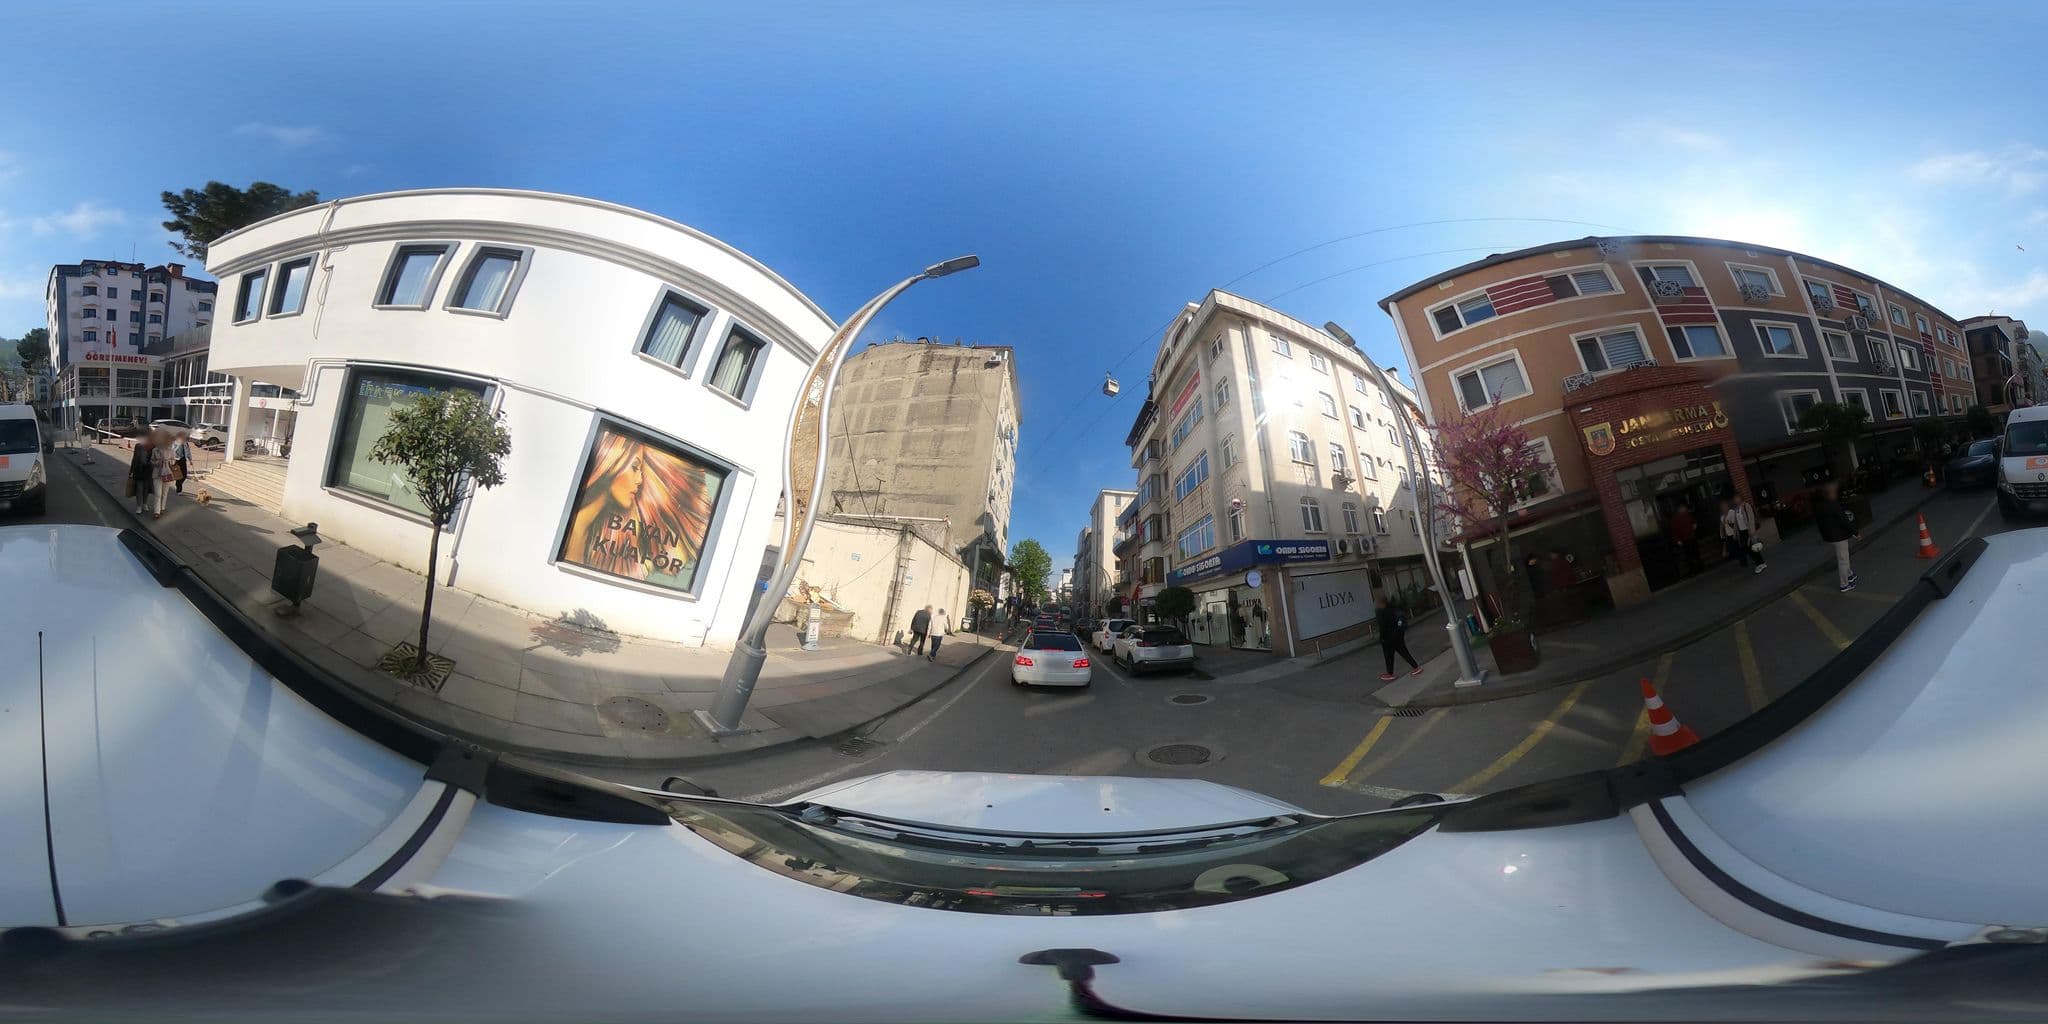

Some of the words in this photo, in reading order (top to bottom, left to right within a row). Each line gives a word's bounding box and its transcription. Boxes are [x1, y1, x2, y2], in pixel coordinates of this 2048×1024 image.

[85, 351, 148, 364] ÖĞRETMENEVİ
[1620, 405, 1708, 434] JANRMA
[608, 512, 680, 547] BAYAN
[593, 536, 683, 574] KUAFÖR
[1319, 591, 1355, 609] LİDYA
